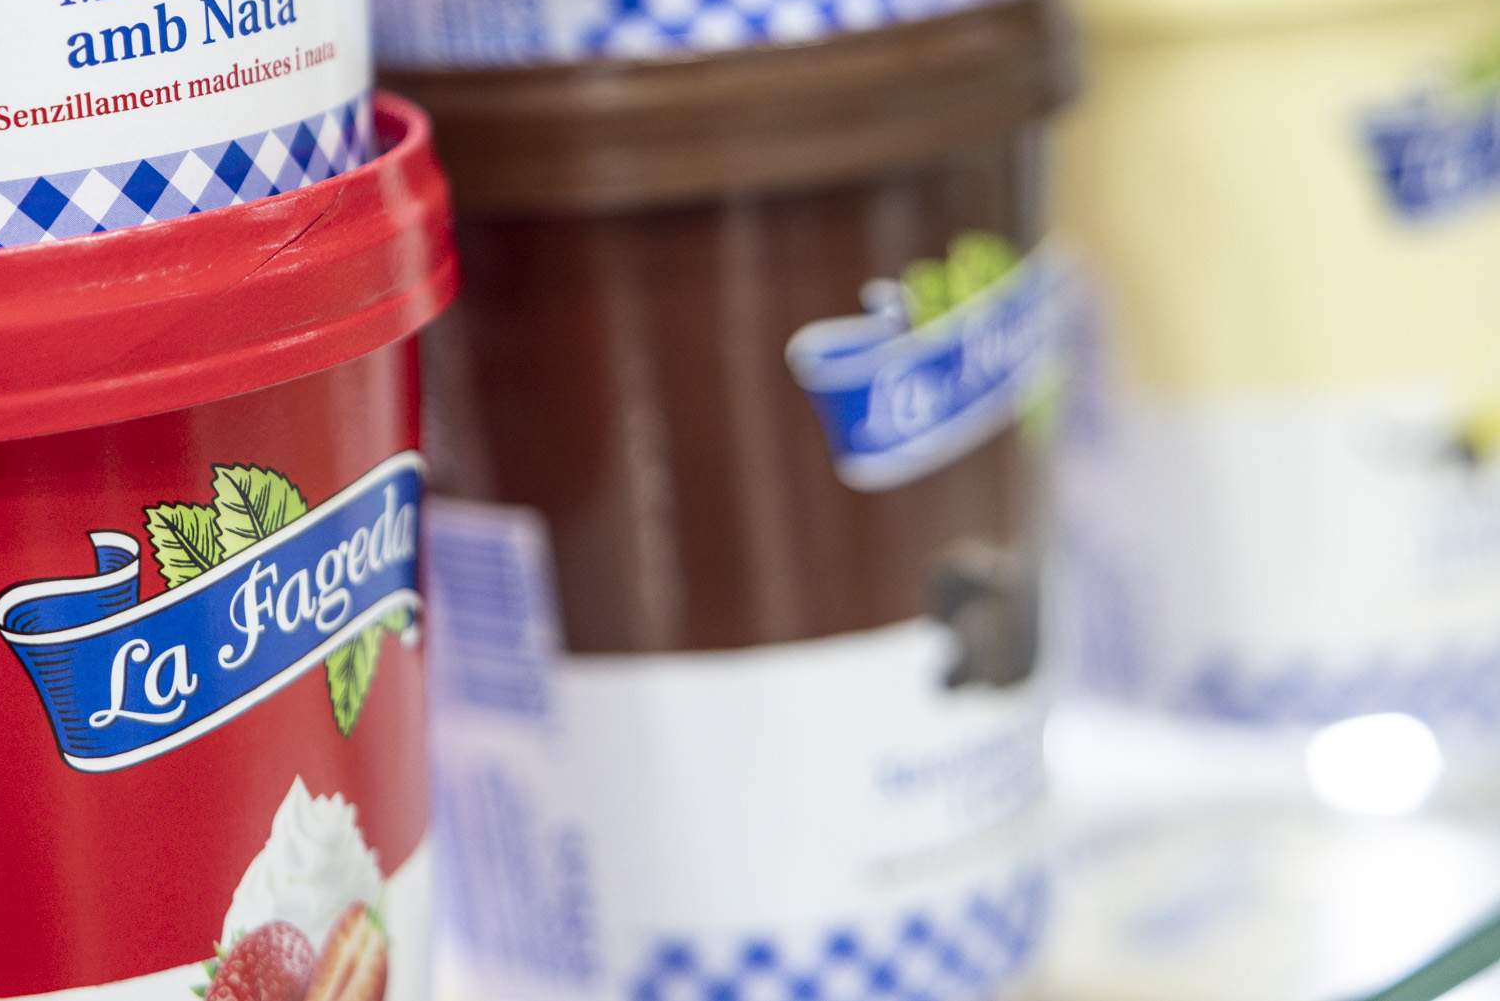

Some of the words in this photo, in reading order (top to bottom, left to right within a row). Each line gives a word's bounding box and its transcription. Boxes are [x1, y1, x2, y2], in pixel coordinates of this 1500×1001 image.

[66, 1, 188, 69] amb
[187, 56, 293, 100] maduixes
[295, 46, 303, 72] i
[304, 40, 337, 68] nata
[89, 637, 198, 729] La
[217, 483, 415, 669] Fageda
